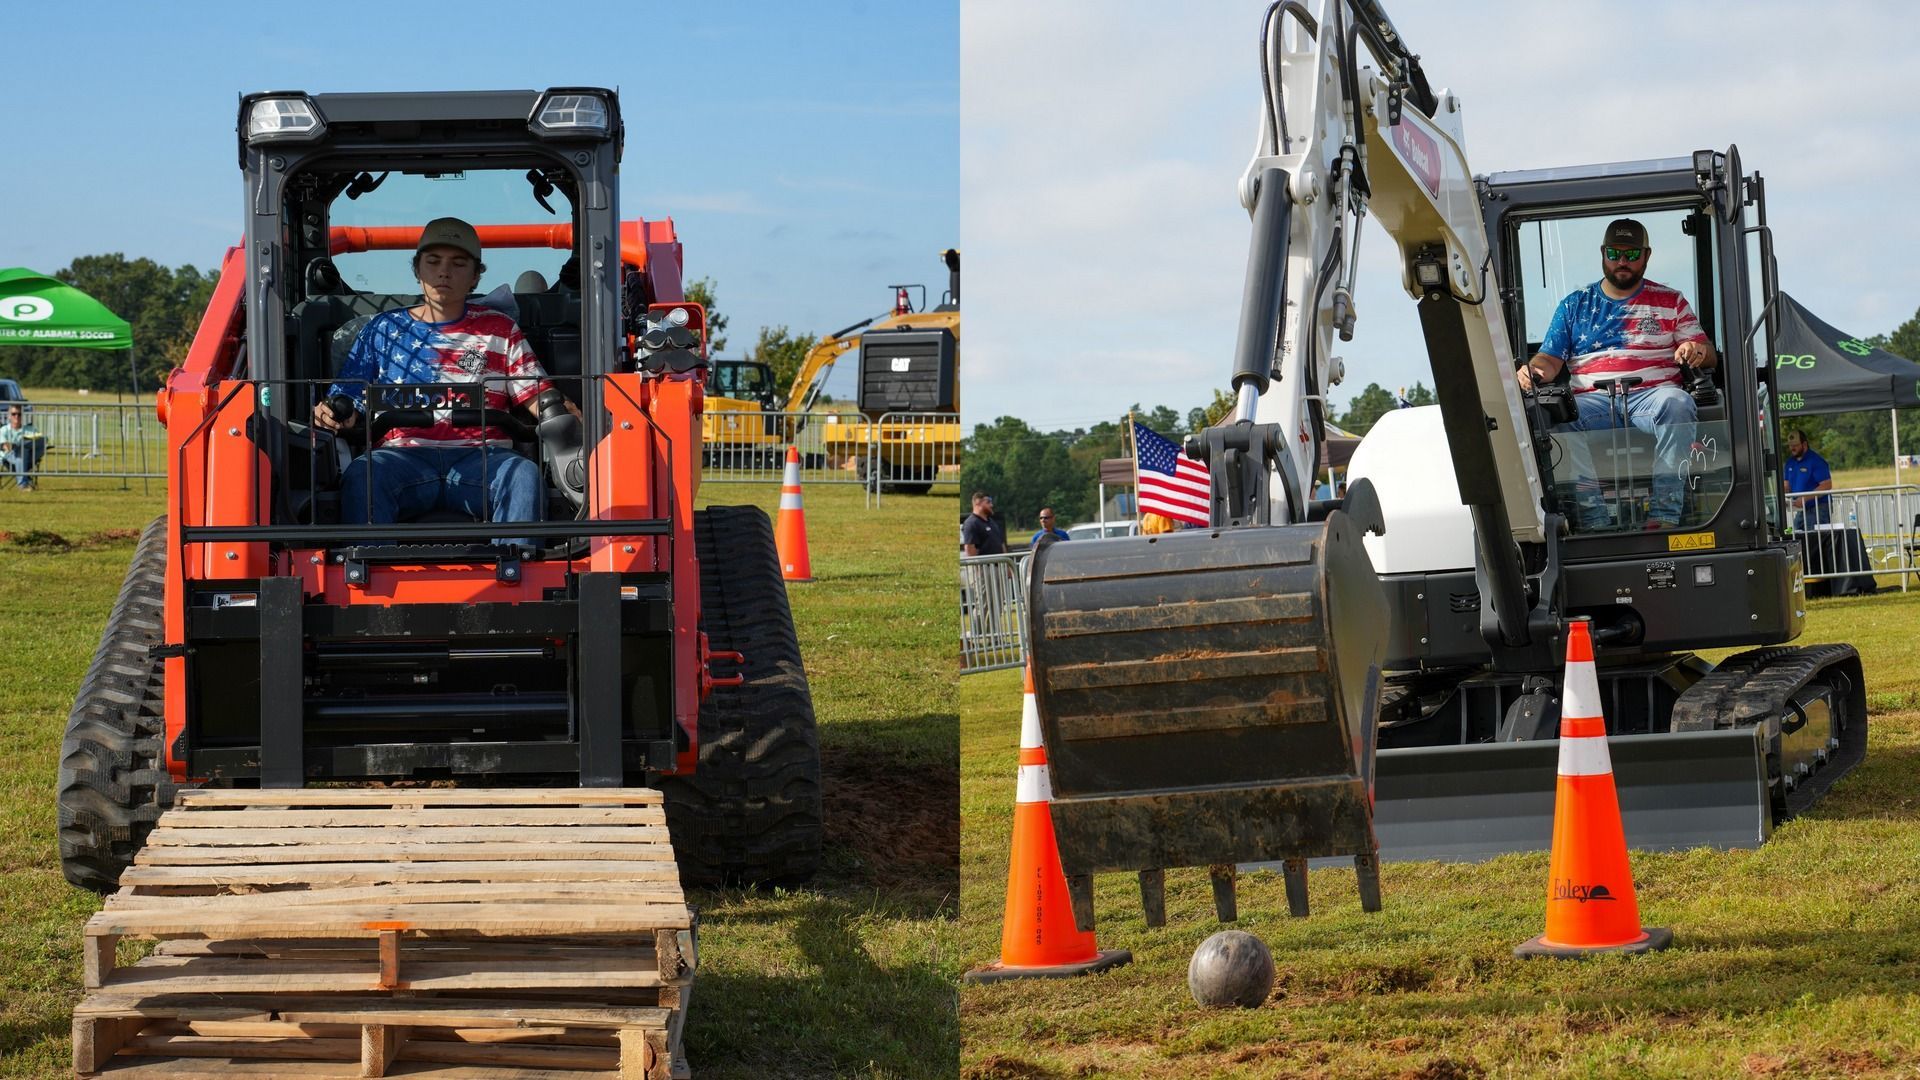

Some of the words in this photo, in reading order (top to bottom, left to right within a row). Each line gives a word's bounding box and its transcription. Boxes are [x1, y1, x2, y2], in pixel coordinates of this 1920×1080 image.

[0, 329, 16, 337] TER
[32, 330, 78, 338] ALABAMA
[80, 330, 114, 339] SOCCER
[891, 357, 911, 372] CAT
[1774, 354, 1816, 370] PG
[1778, 392, 1804, 402] NTAL
[1779, 401, 1805, 410] ROUP
[1554, 878, 1592, 903] Foley
